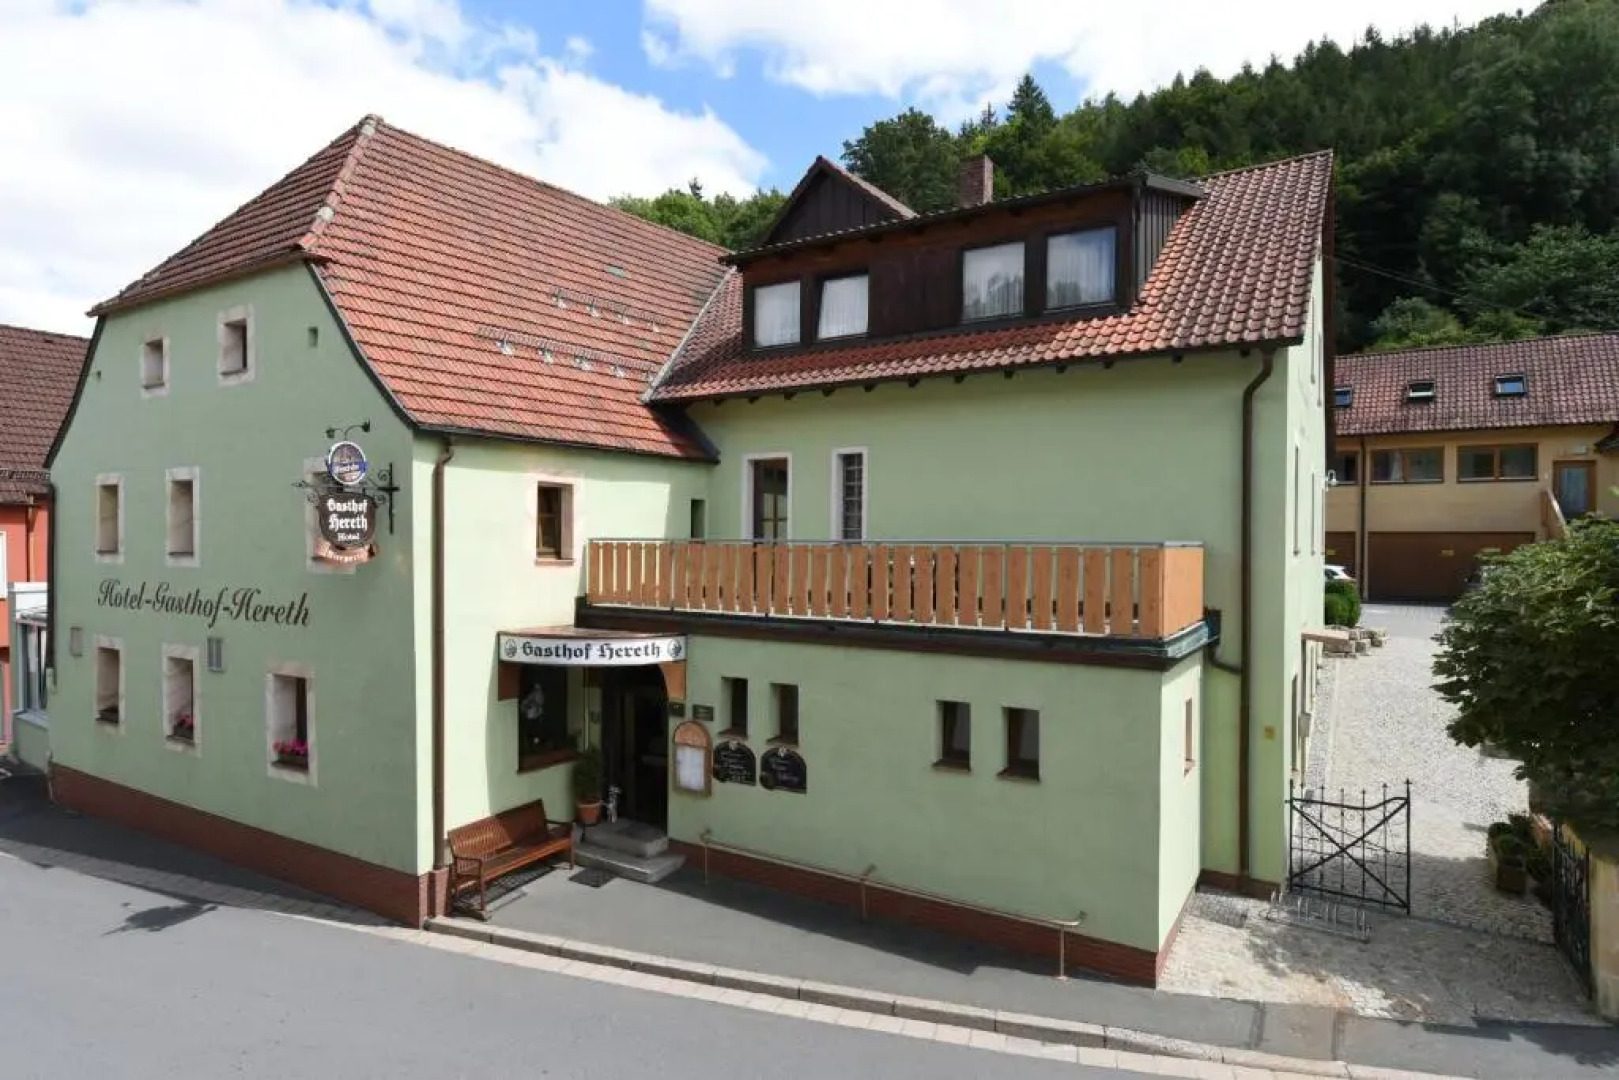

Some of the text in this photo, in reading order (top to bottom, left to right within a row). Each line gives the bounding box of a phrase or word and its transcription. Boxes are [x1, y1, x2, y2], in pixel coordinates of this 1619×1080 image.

[326, 499, 368, 515] Gasthof
[328, 514, 368, 532] Hereth
[97, 578, 310, 629] Hotel-Gasthof-Hereth
[521, 641, 661, 660] Gasthof Hereth
